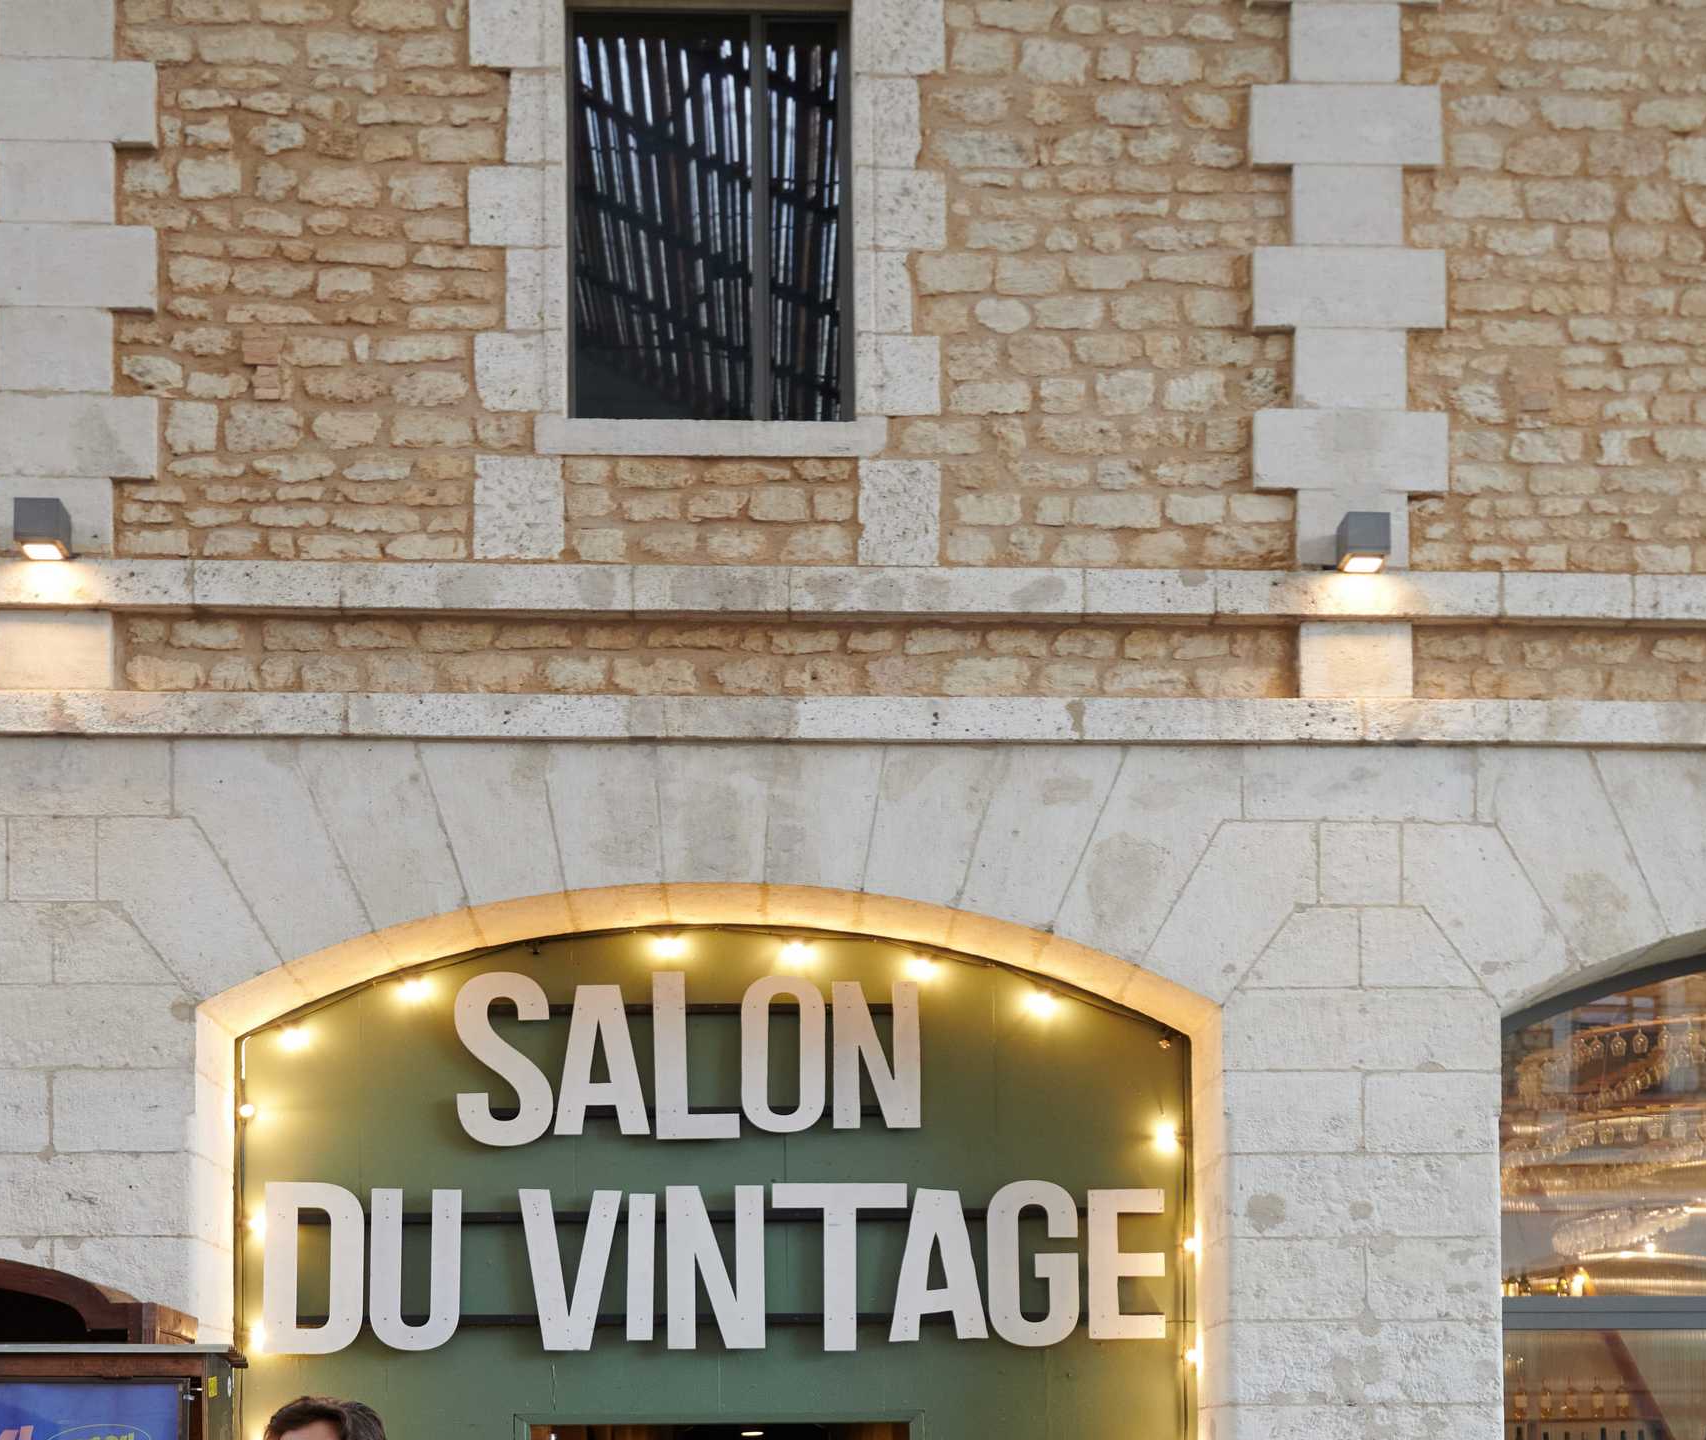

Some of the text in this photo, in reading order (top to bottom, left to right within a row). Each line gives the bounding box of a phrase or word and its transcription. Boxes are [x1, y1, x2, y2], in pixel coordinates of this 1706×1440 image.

[453, 970, 922, 1147] SALON
[262, 1179, 1166, 1355] DU VINTAGE
